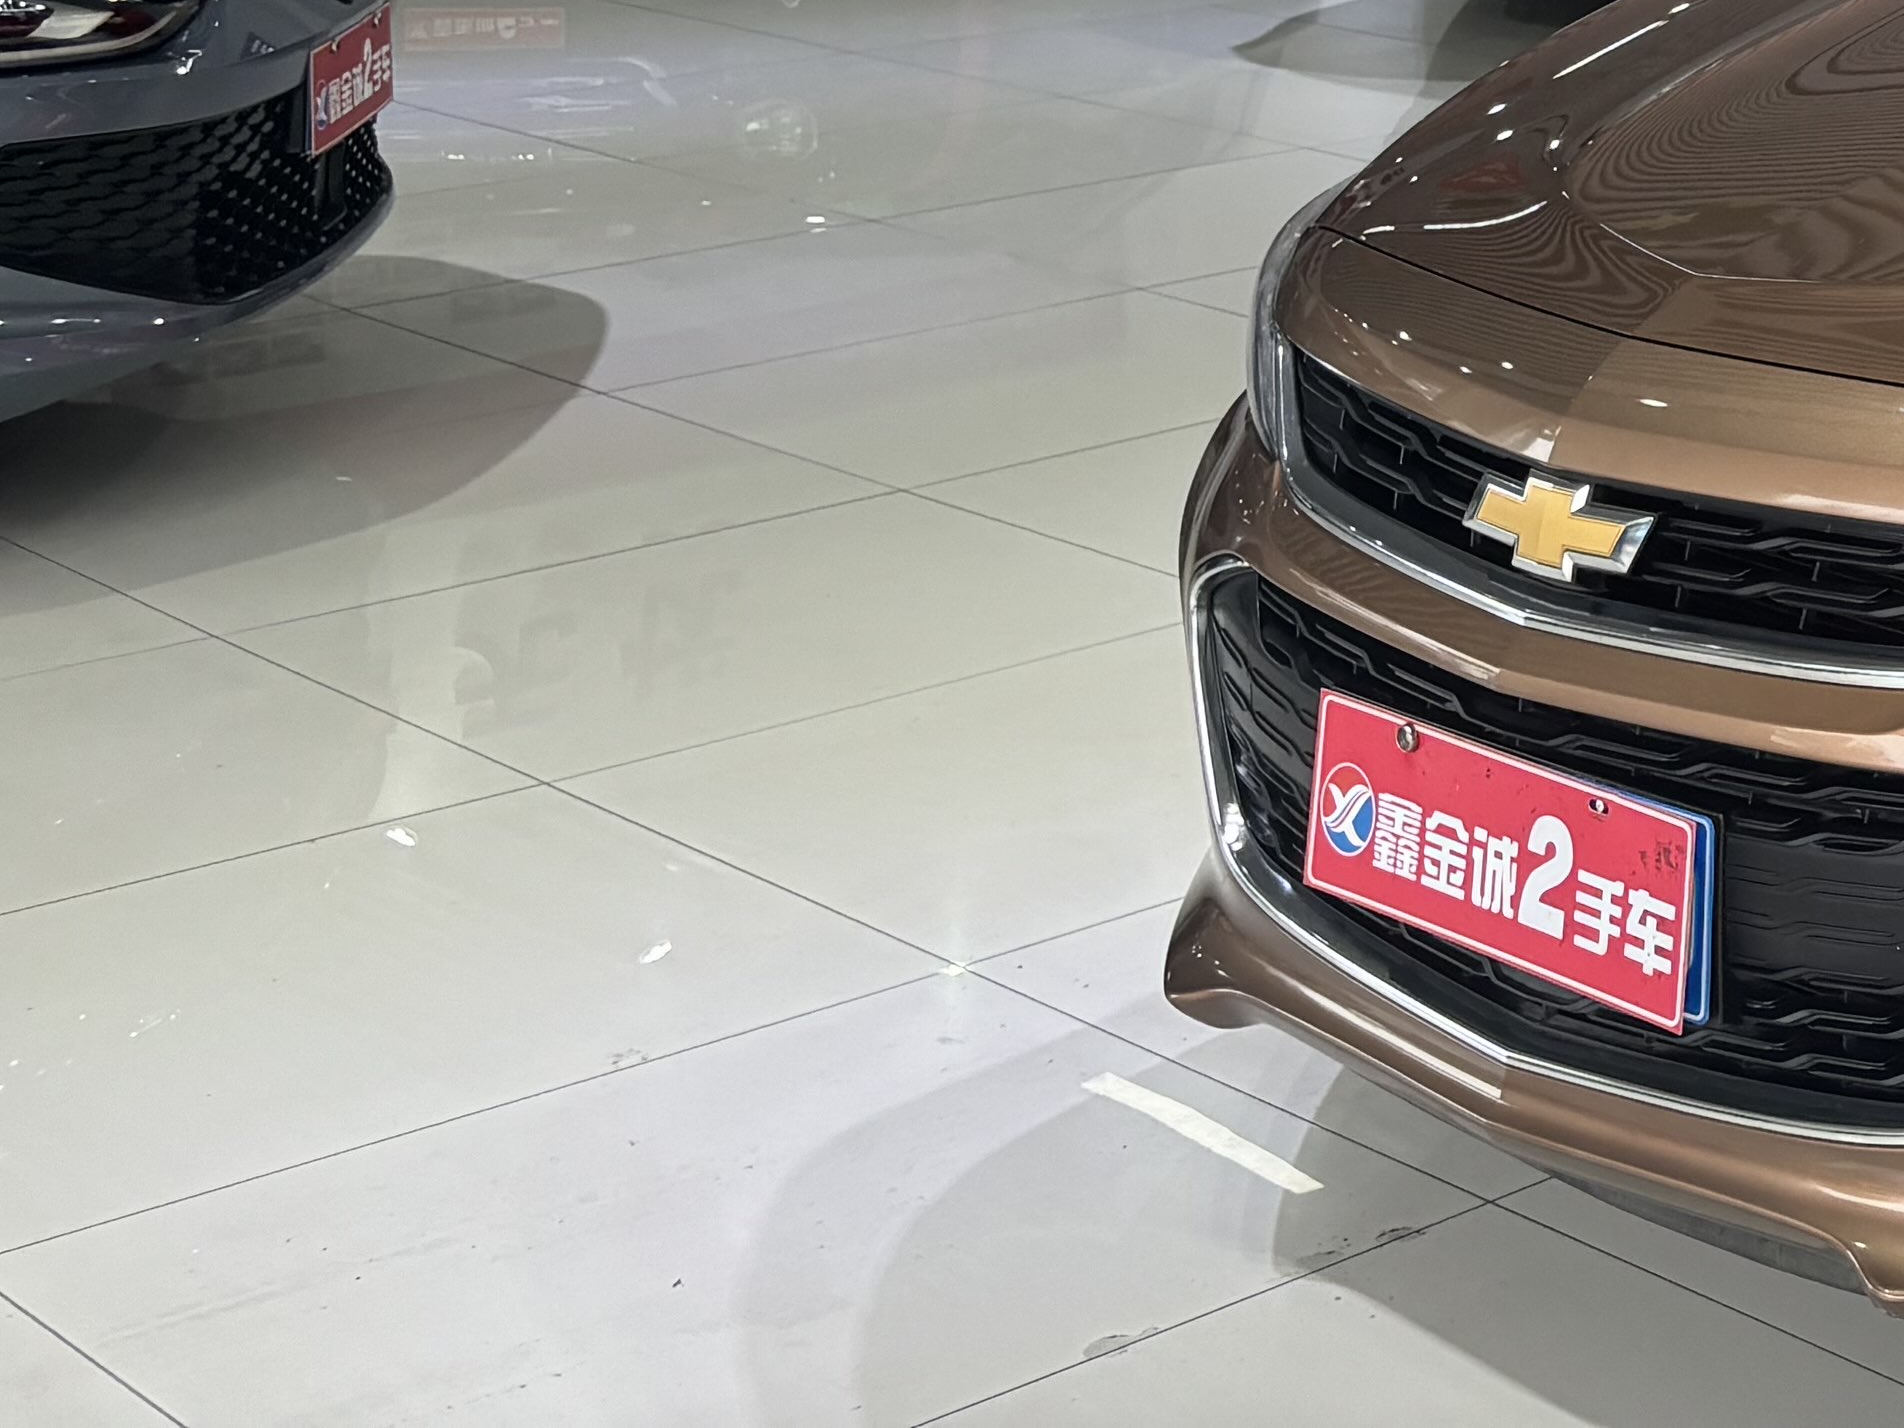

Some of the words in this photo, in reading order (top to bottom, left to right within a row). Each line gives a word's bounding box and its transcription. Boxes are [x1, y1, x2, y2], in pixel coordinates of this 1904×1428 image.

[1372, 792, 1676, 976] 鑫金诚2手车
